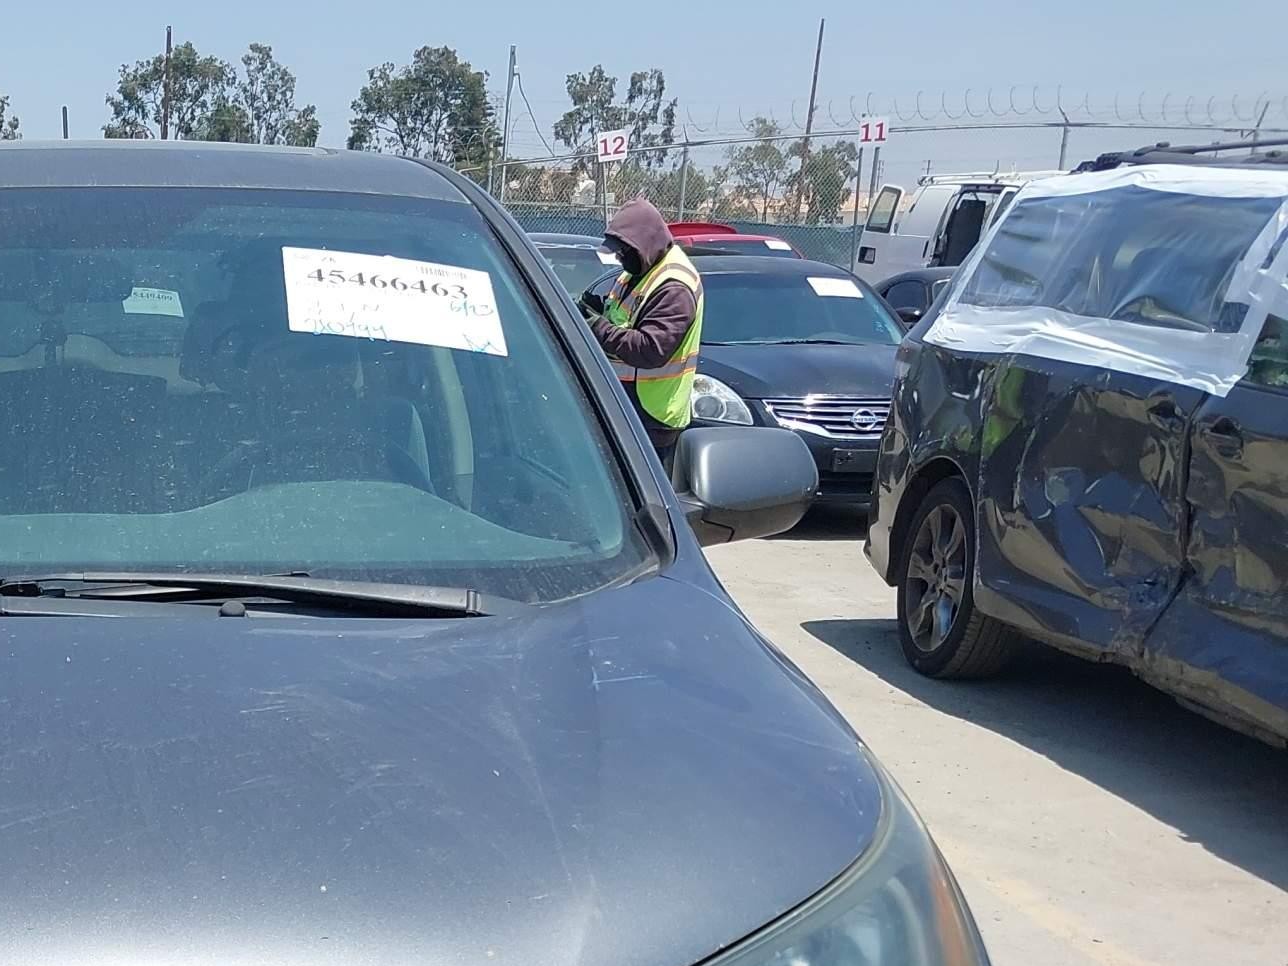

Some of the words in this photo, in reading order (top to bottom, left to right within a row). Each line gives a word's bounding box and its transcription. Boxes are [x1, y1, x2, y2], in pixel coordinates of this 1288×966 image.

[860, 122, 886, 142] 11
[599, 135, 626, 157] 12
[306, 268, 469, 300] 45466463
